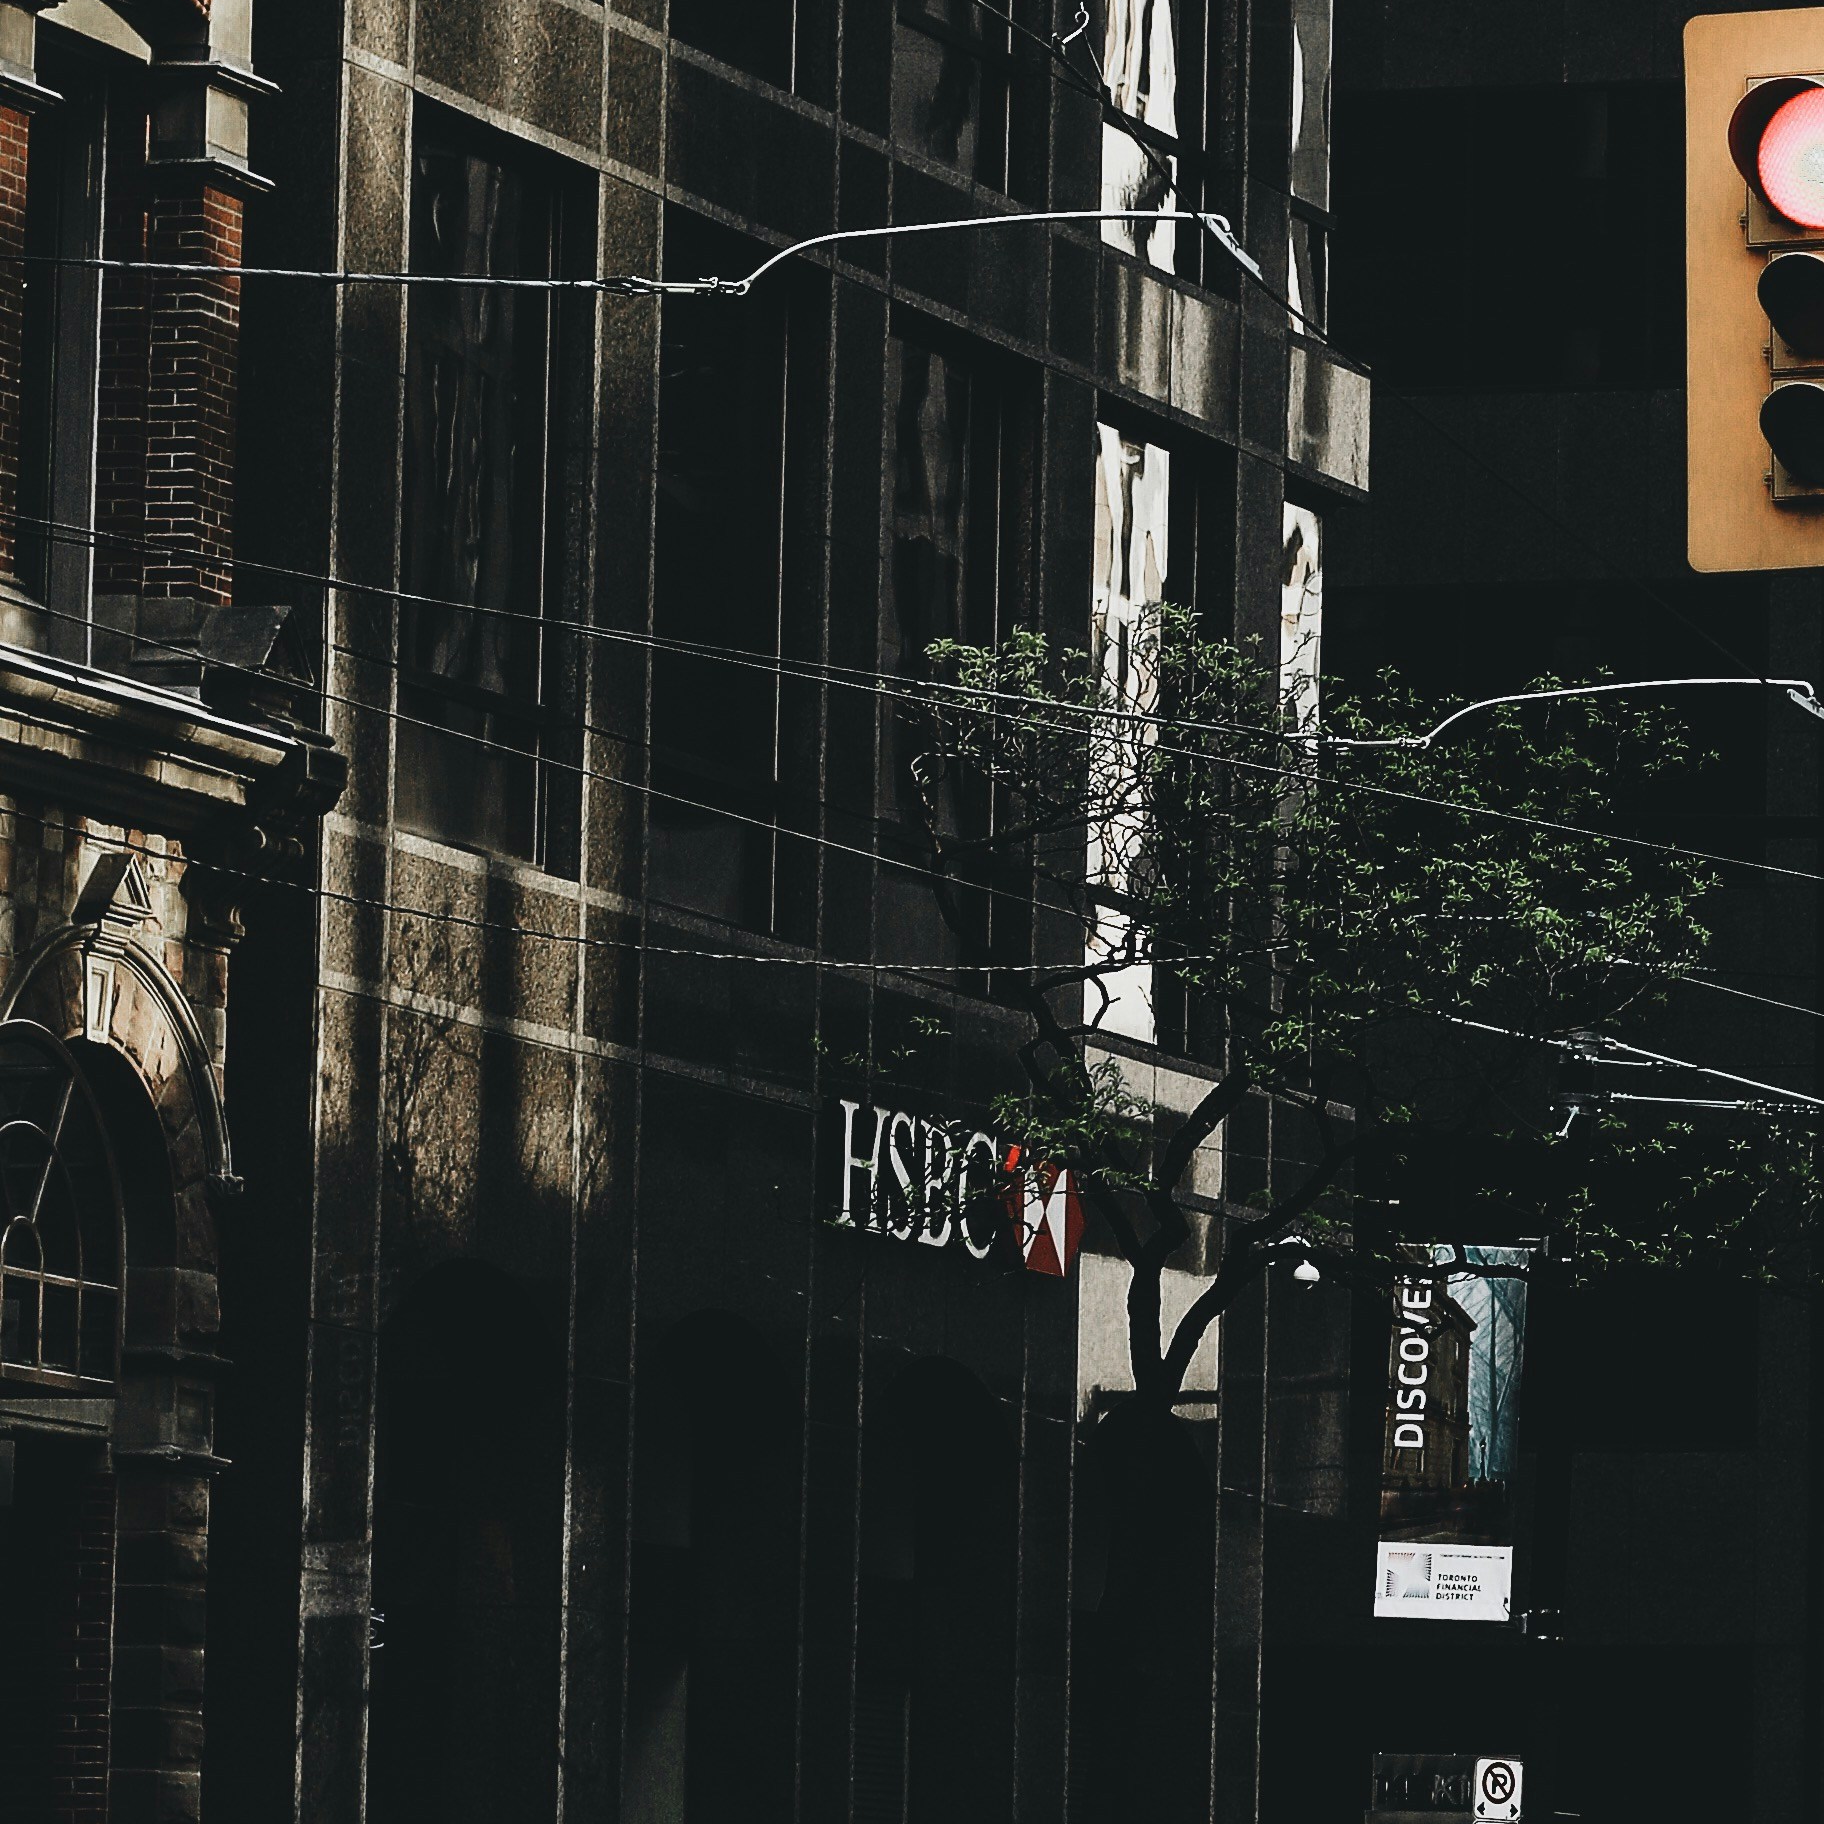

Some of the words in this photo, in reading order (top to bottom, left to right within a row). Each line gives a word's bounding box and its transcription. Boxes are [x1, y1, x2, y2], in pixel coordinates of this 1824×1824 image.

[838, 1098, 998, 1260] HSBC
[1437, 1573, 1479, 1583] TORONTO
[1435, 1592, 1475, 1601] DISTRICT
